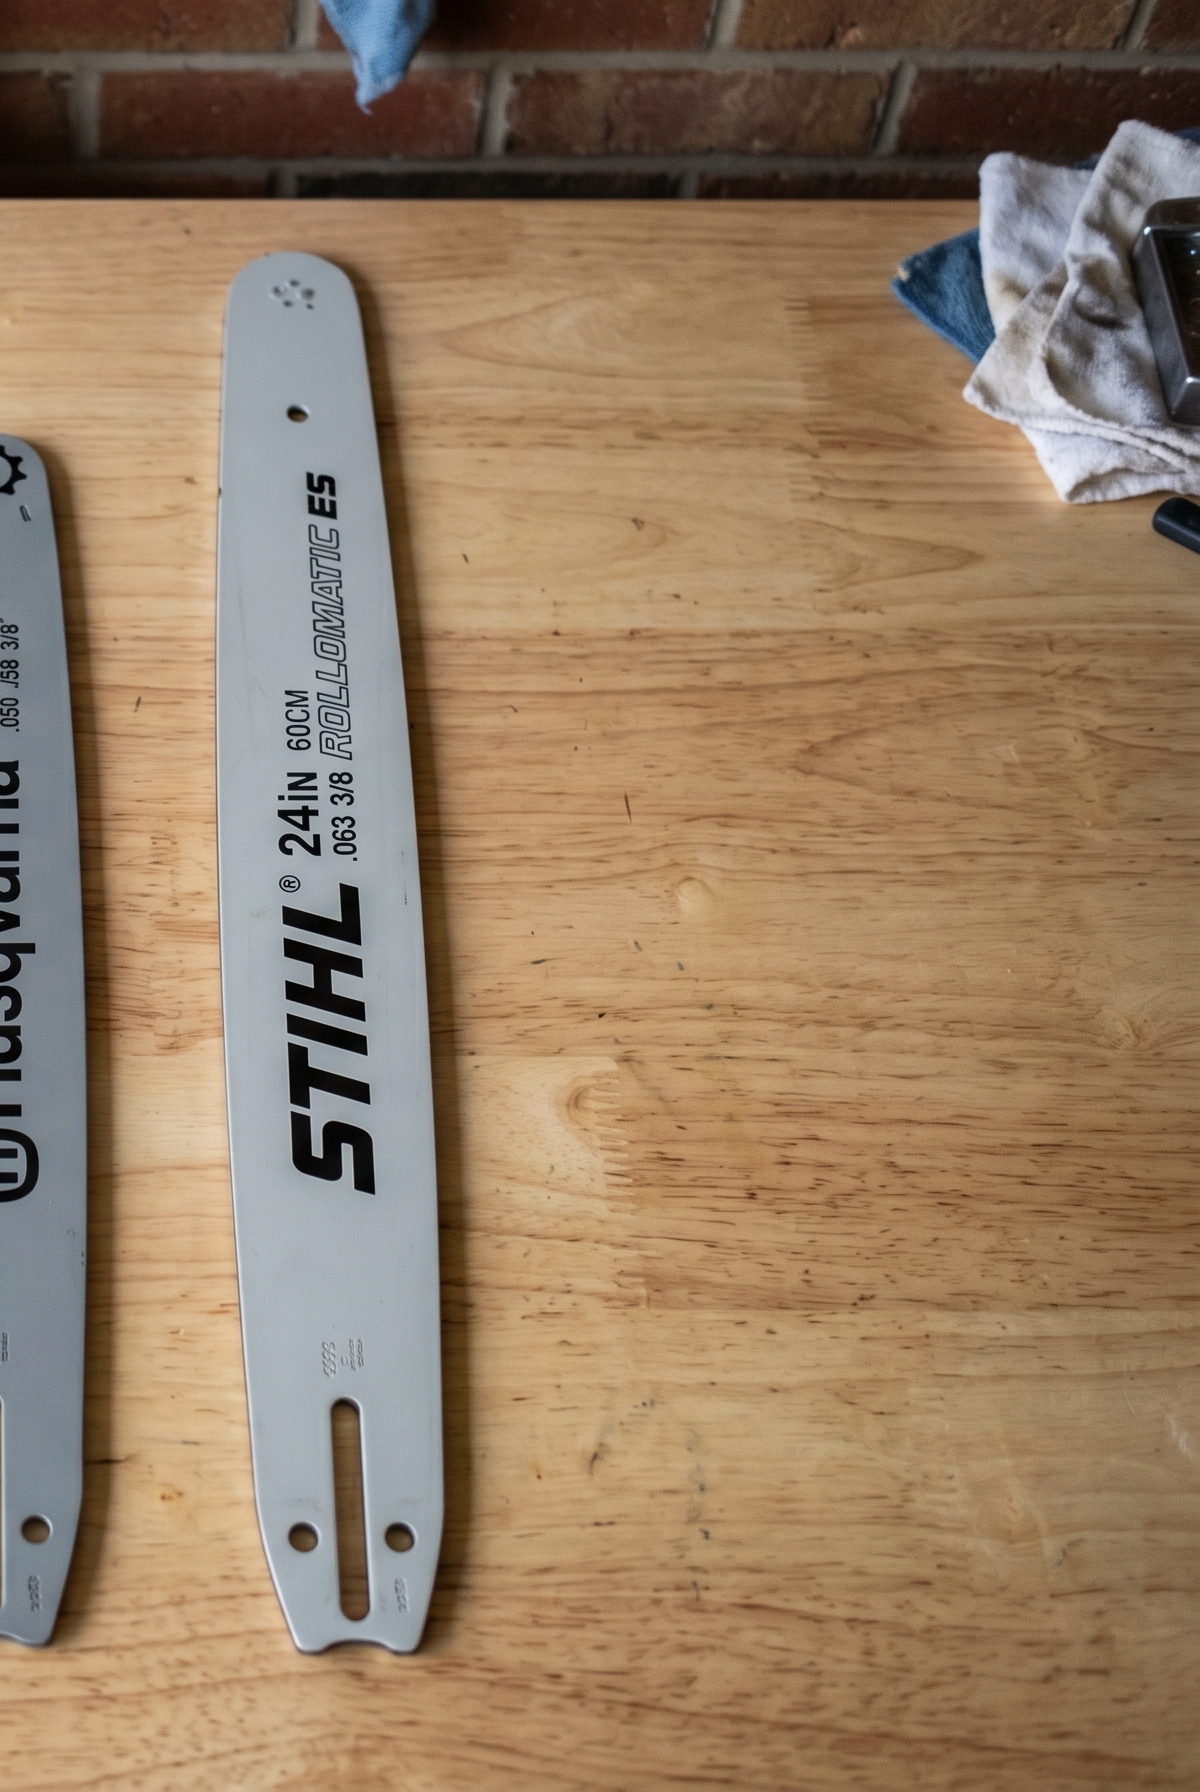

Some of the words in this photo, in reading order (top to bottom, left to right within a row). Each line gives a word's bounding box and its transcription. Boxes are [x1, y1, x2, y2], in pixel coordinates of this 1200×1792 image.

[306, 471, 338, 521] ES
[308, 524, 353, 761] ROLLOMATIC
[0, 697, 20, 733] .050
[284, 689, 311, 752] 60CM
[328, 771, 354, 807] 3/8
[331, 815, 358, 862] .063
